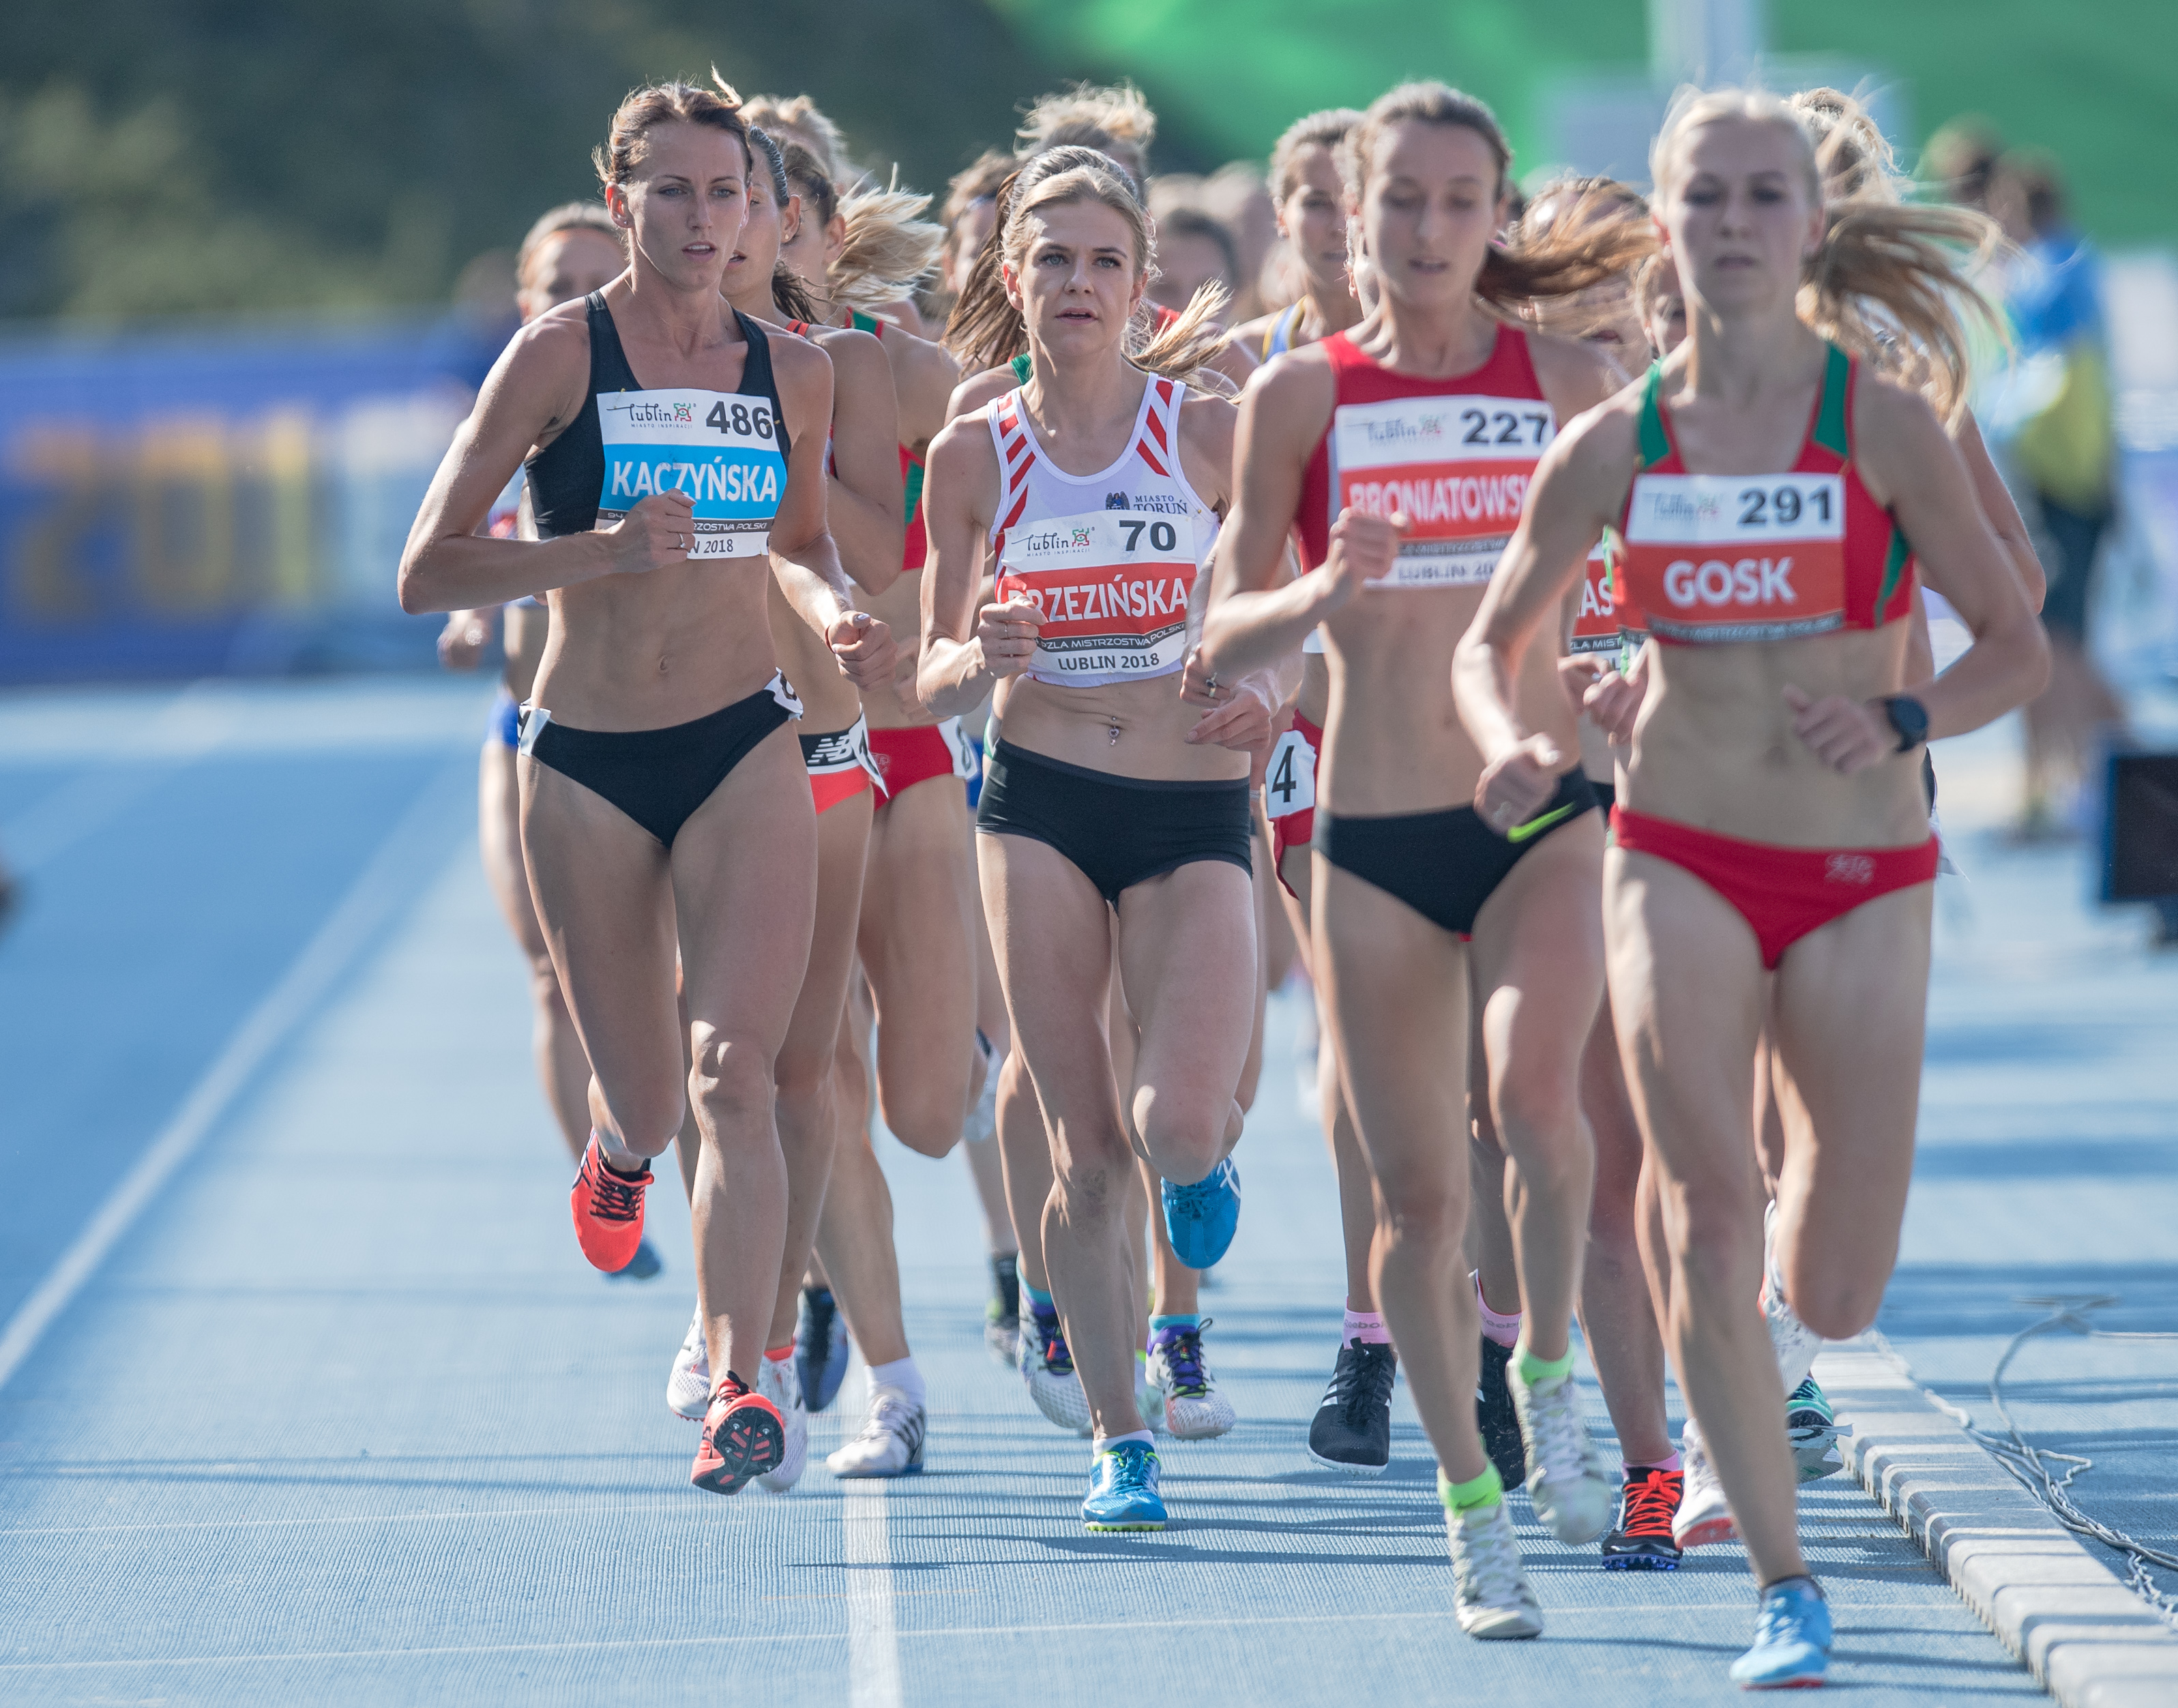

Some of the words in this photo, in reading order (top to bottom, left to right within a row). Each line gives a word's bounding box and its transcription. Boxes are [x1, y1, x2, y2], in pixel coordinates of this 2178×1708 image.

[705, 400, 773, 439] 486
[1460, 407, 1549, 445] 227
[611, 456, 777, 502] KACZYŃSKA
[1133, 499, 1188, 514] TORUŃ
[1349, 473, 1533, 524] BRONIATOWS
[1737, 484, 1832, 527] 291
[735, 522, 767, 531] POLSKI
[1119, 520, 1177, 552] 70
[704, 538, 734, 554] 2018
[1663, 556, 1797, 607] GOSK
[1071, 637, 1151, 648] MISTRZOSTWA
[1149, 623, 1186, 641] POLSKI
[1058, 655, 1116, 671] LUBLIN
[1121, 652, 1160, 669] 2018
[1271, 745, 1297, 803] 4
